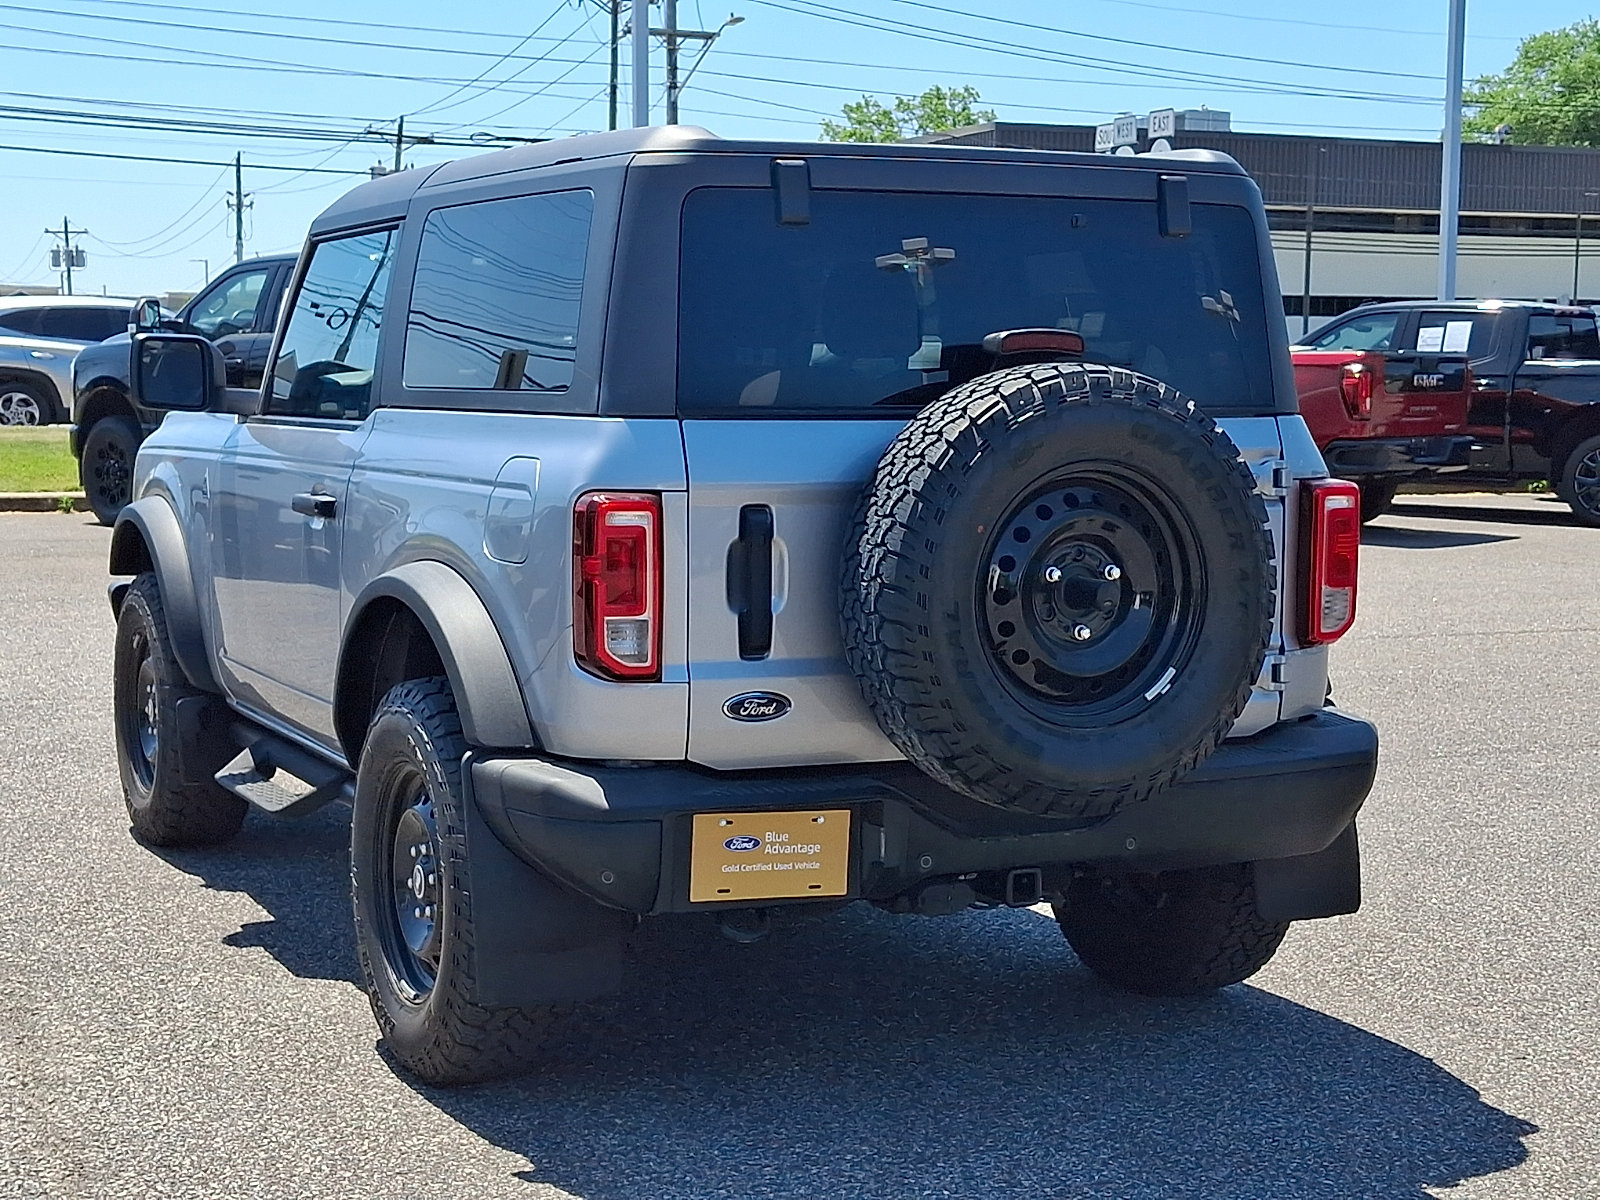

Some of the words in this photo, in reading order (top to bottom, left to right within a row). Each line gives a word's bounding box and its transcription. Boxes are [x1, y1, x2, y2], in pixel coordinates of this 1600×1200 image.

[1116, 121, 1134, 138] WEST
[1152, 115, 1170, 133] EAST
[1413, 374, 1445, 387] GMC
[740, 699, 777, 715] Ford
[729, 837, 756, 850] Ford
[765, 831, 789, 843] Blue
[764, 843, 821, 855] Advantage
[721, 864, 740, 873] Gold
[740, 863, 772, 872] Certified
[773, 862, 793, 871] Used
[793, 861, 821, 870] Vehicle
